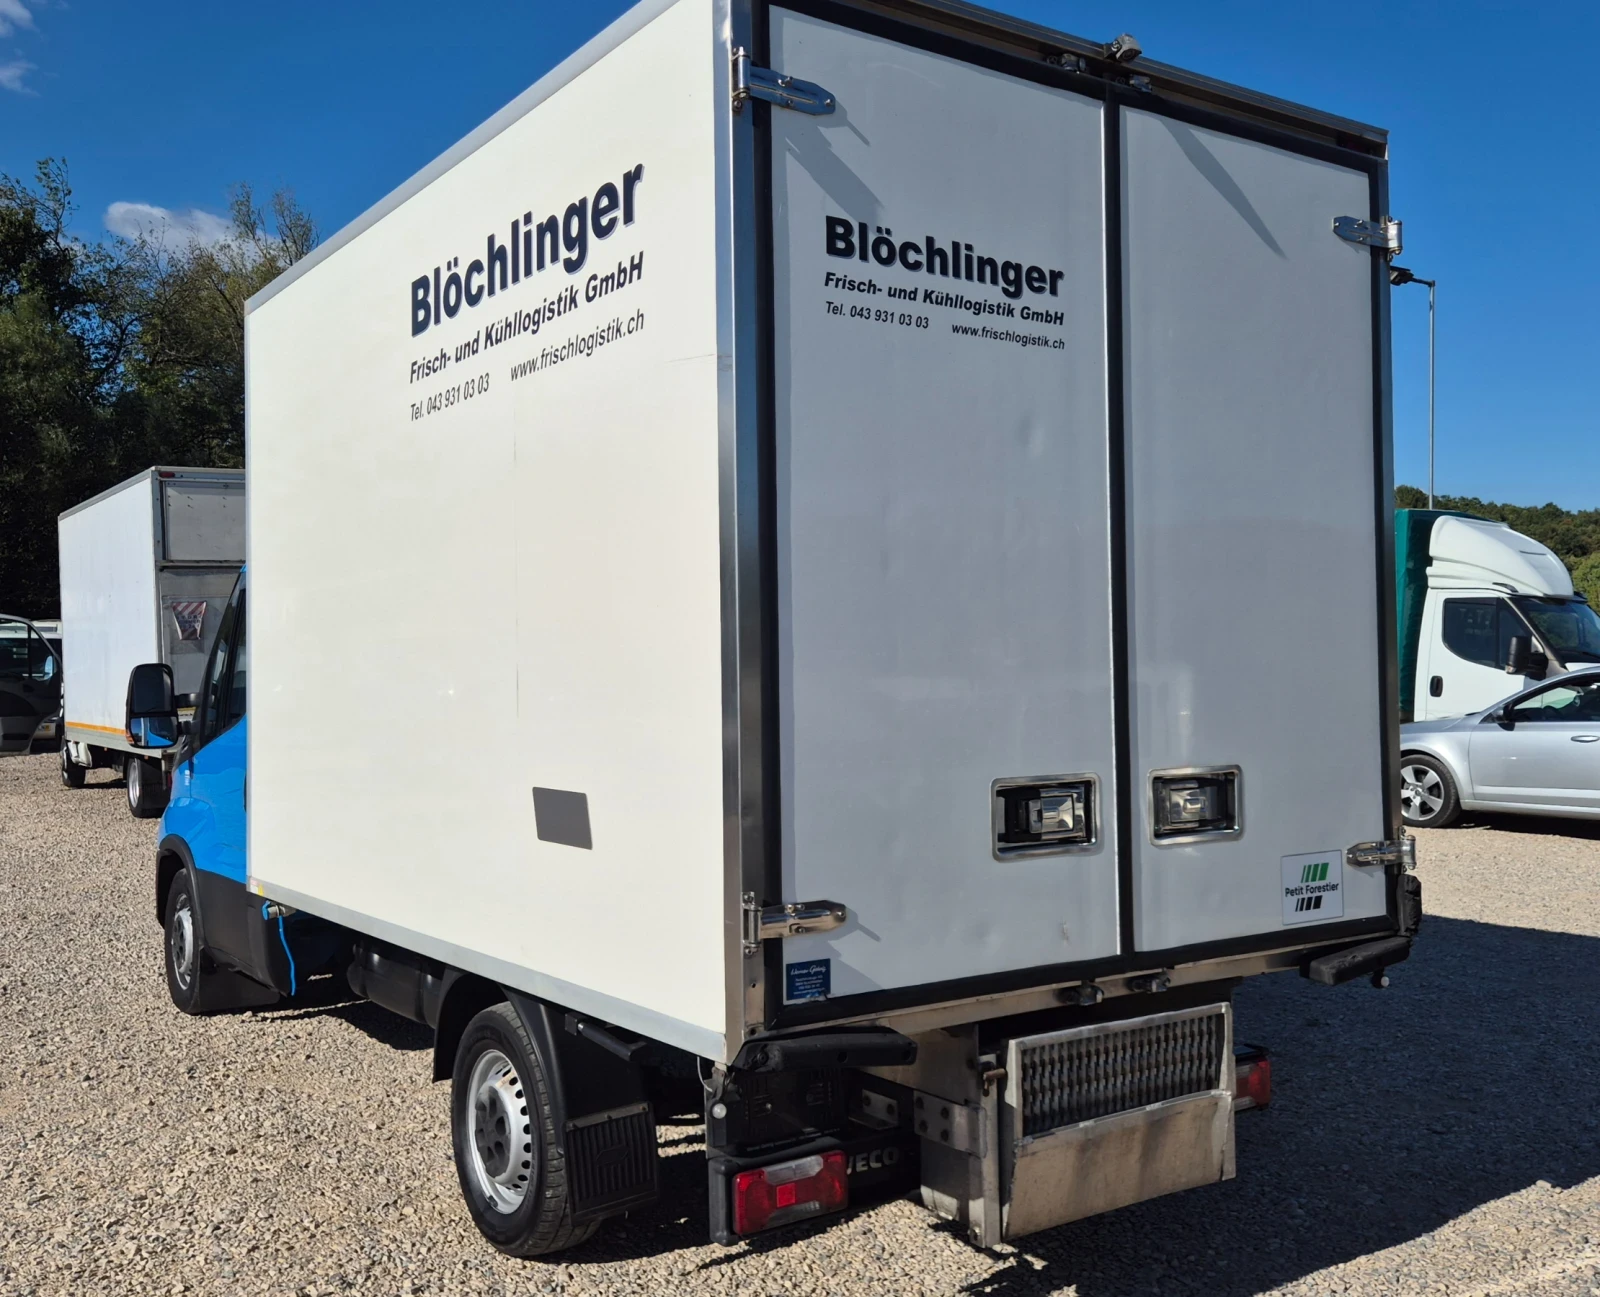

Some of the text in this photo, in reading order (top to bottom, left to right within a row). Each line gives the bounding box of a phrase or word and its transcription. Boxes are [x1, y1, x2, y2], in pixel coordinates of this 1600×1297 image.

[411, 163, 645, 338] Blöchlinger
[826, 215, 1065, 300] Blöchlinger
[410, 250, 644, 384] Frisch- und Kühllogistik GmbH
[824, 271, 1064, 326] Frisch- und Kühllogistik GmbH
[826, 301, 929, 330] Tel. 043 931 03 03
[510, 308, 645, 381] www.frischlogistik.ch
[951, 323, 1066, 351] www.frischlogistik.ch
[411, 372, 490, 422] Tel. 043 931 03 03
[1284, 882, 1339, 898] Petit Forestier
